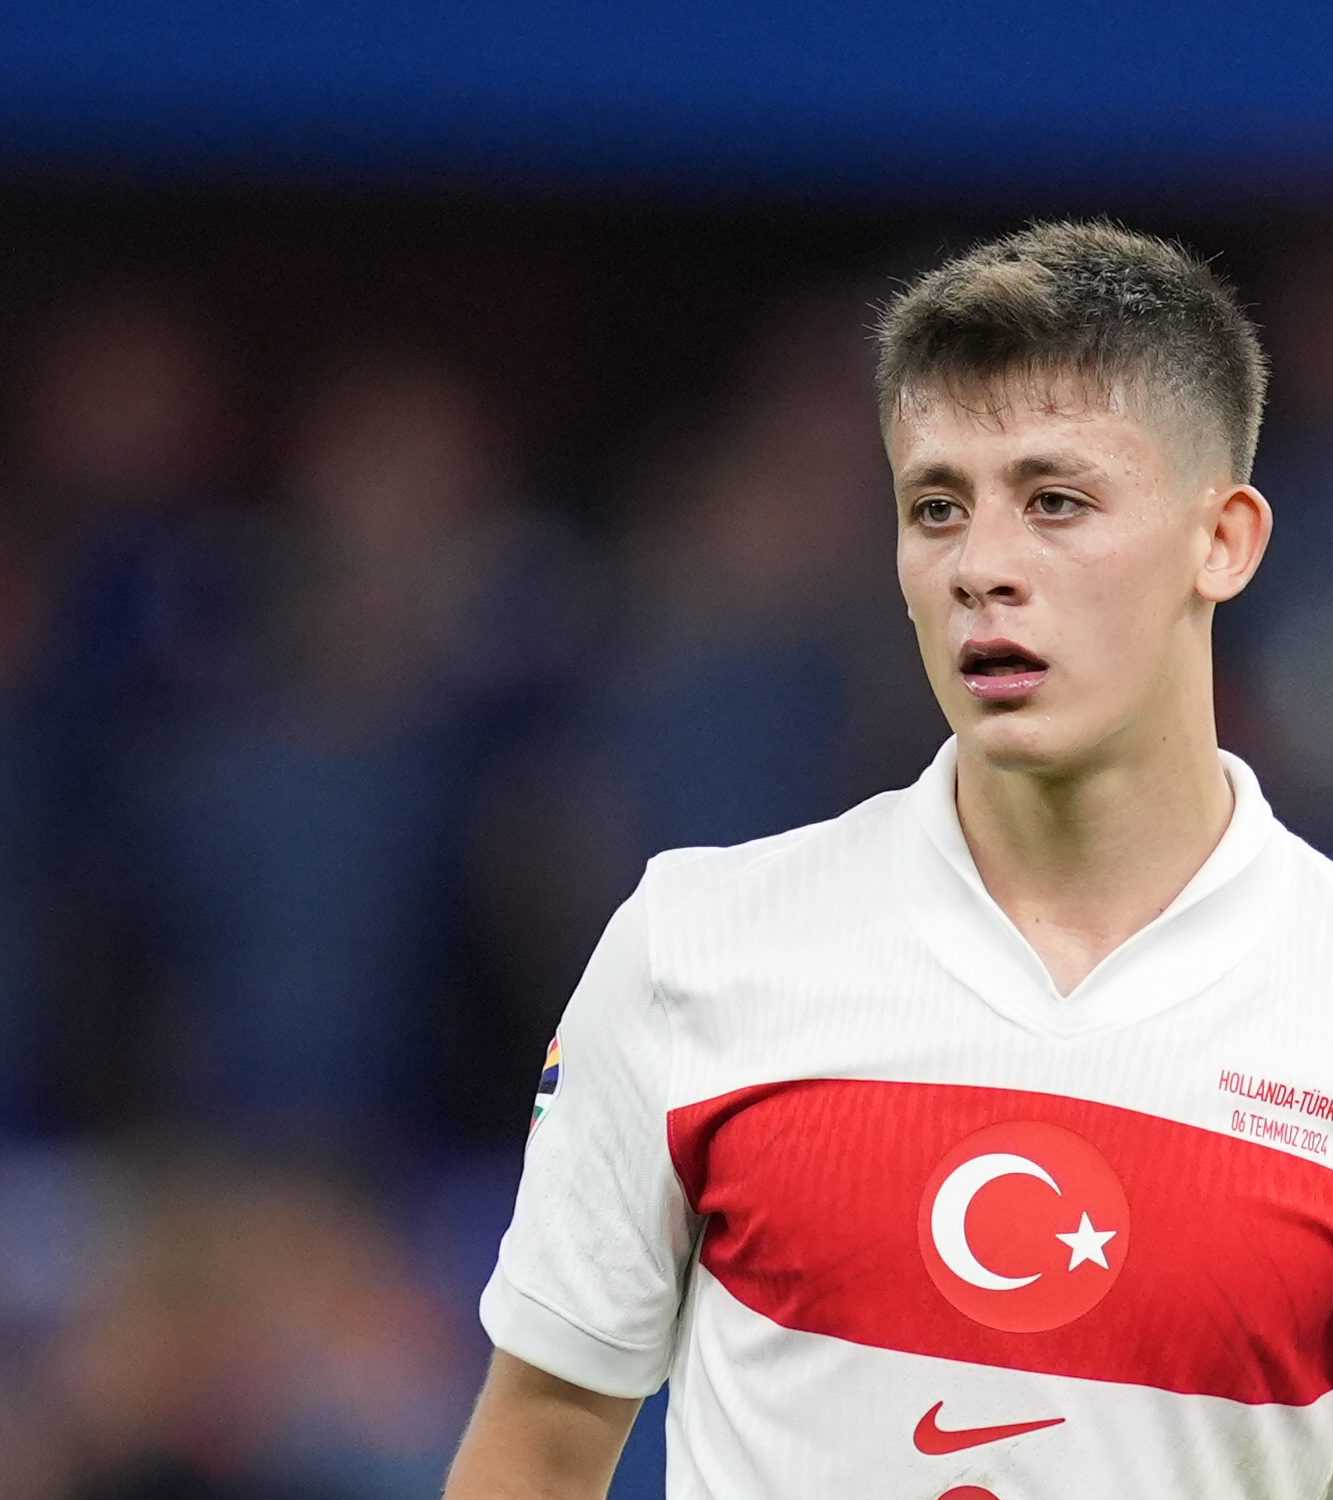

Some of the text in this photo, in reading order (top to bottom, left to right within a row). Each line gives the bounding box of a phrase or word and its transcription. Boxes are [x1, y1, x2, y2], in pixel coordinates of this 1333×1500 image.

[1231, 1109, 1329, 1155] 06 TEMMUZ 2024
